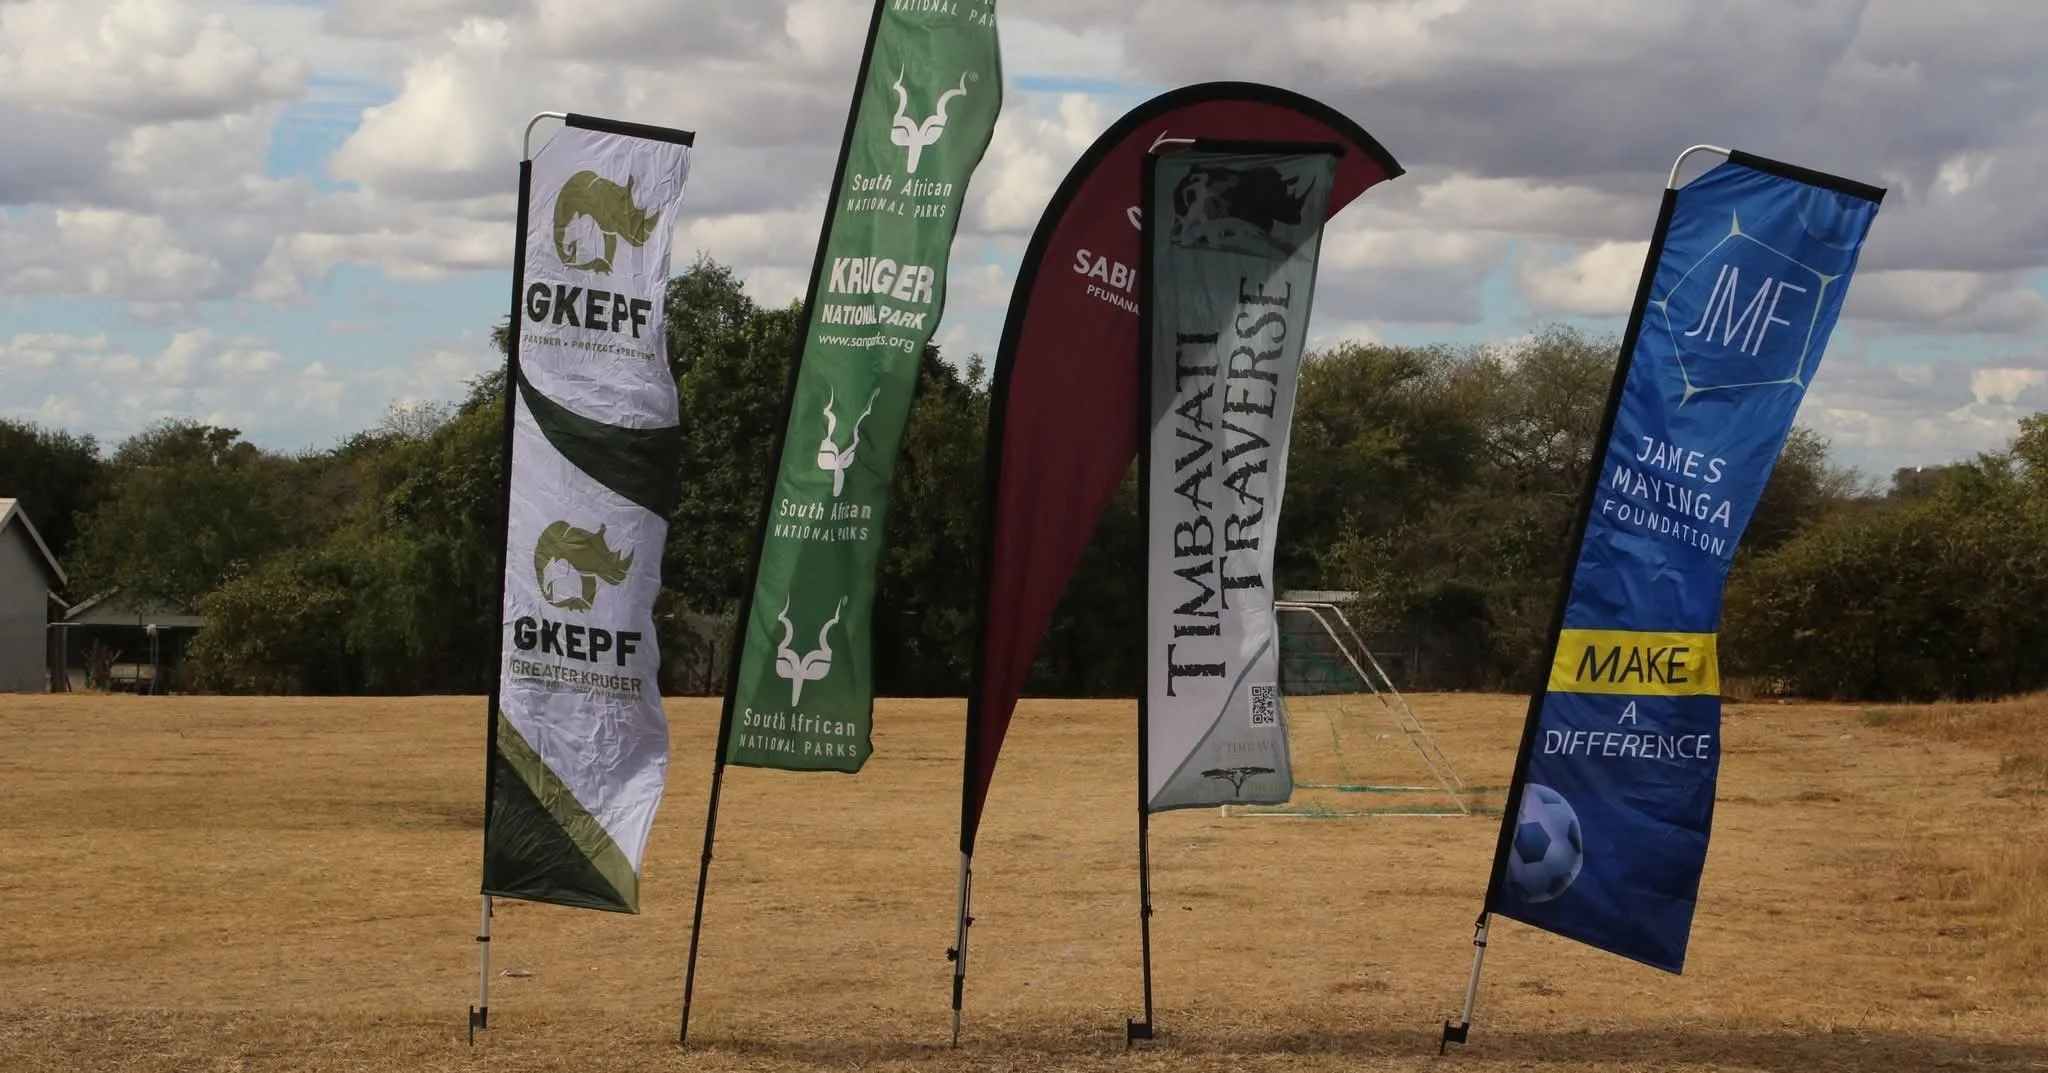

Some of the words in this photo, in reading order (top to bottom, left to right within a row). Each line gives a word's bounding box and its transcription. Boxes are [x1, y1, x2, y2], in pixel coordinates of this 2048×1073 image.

[893, 0, 957, 16] NATIONAL
[852, 174, 893, 192] South
[900, 178, 952, 197] African
[847, 199, 904, 216] NATIONAL
[914, 204, 947, 218] PARKS
[828, 256, 935, 304] KRUGER
[1073, 248, 1137, 293] SABI
[526, 281, 652, 339] GKEPF
[821, 304, 876, 326] NATIONAL
[878, 305, 928, 331] PARK
[1684, 264, 1807, 357] JMF
[571, 340, 613, 353] PROTECT
[818, 332, 915, 354] www.sanparks.org
[1219, 274, 1292, 611] TRAVERSE
[1636, 436, 1727, 484] JAMES
[780, 499, 825, 520] South
[1612, 465, 1732, 528] MAYINGA
[1167, 331, 1226, 697] TIMBAVATI
[1602, 500, 1726, 556] FOUNDATION
[774, 523, 835, 542] NATIONAL
[513, 616, 642, 667] GKEPF
[512, 659, 578, 682] GREATER
[581, 671, 642, 693] KRUGER
[1575, 645, 1690, 684] MAKE
[743, 708, 786, 731] South
[790, 713, 856, 737] African
[1618, 700, 1638, 725] A
[740, 734, 795, 753] NATIONAL
[804, 741, 857, 757] PARKS
[1544, 730, 1711, 760] DIFFERENCE
